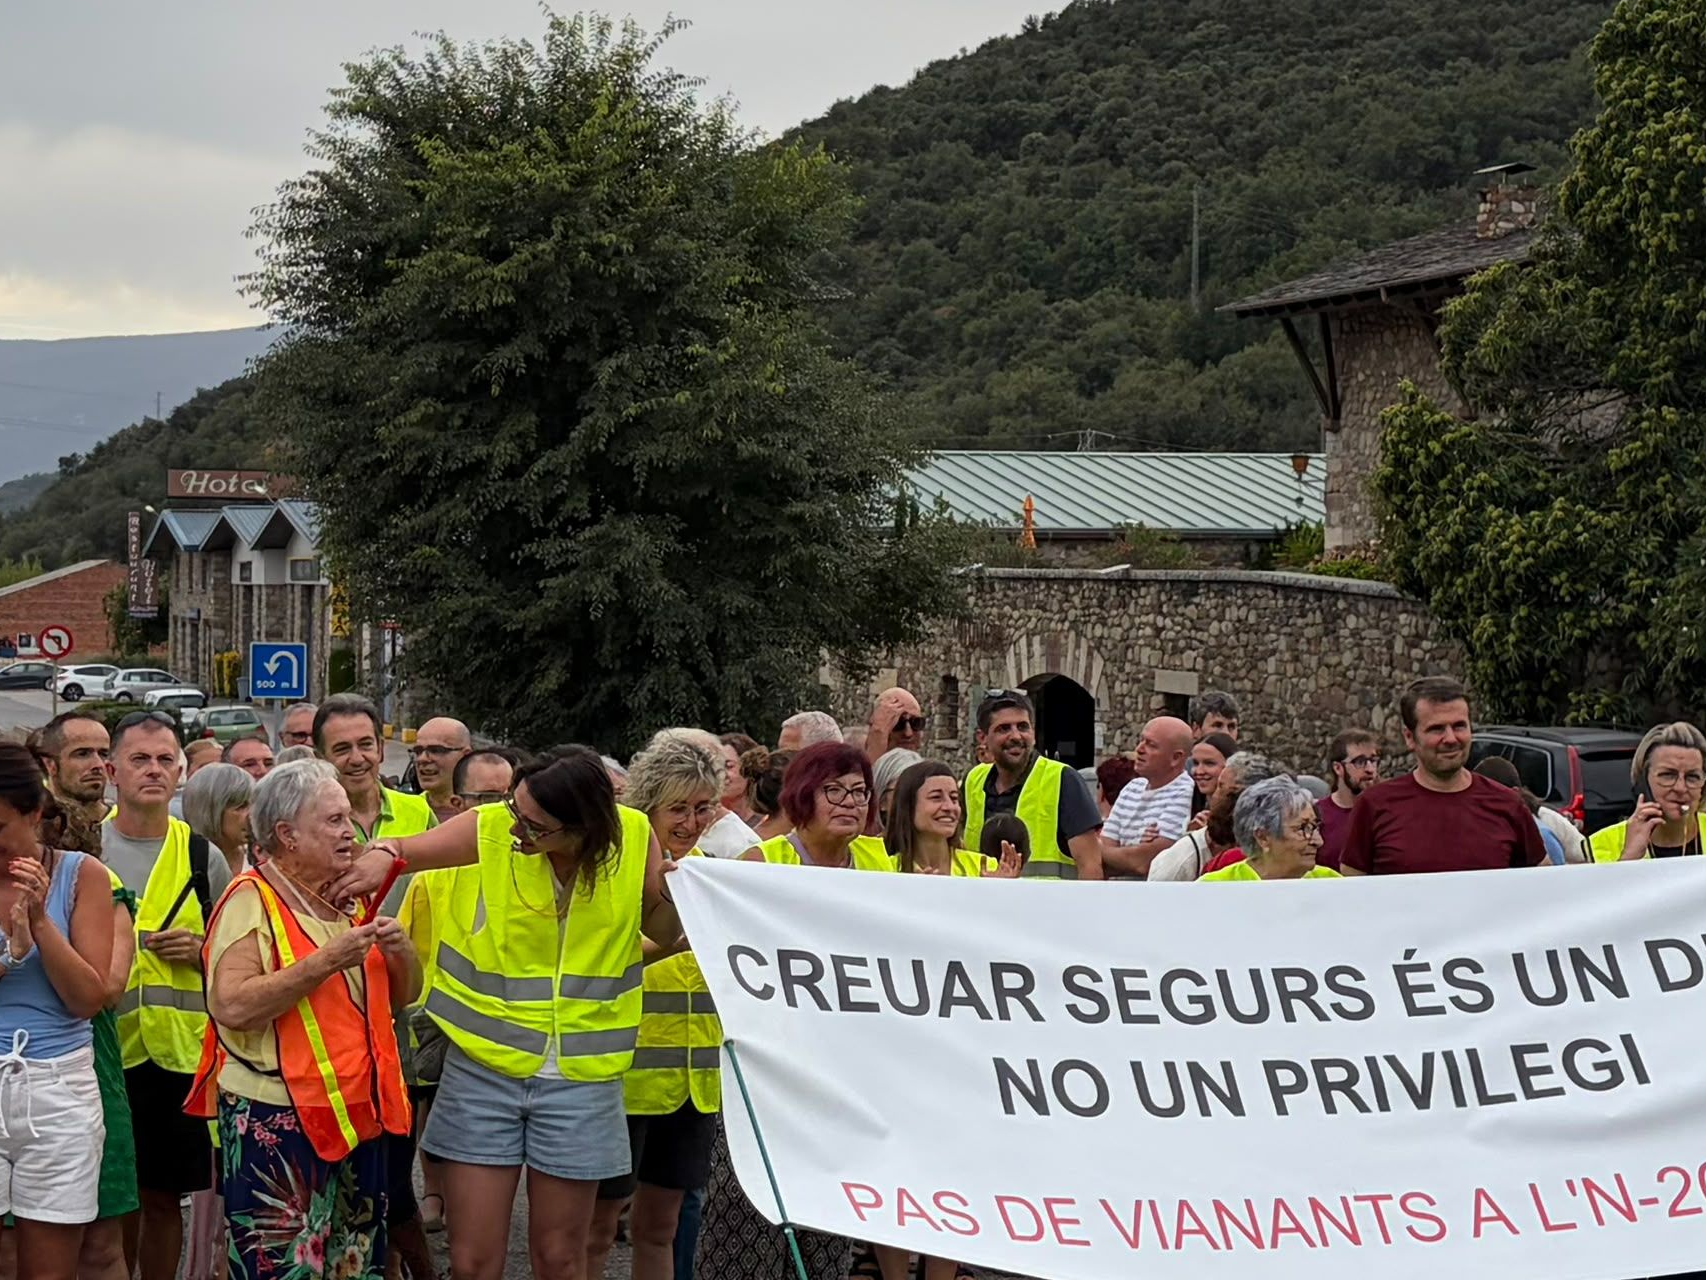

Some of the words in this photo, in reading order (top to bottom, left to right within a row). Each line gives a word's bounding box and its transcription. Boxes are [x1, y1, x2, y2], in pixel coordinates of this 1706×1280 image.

[726, 943, 1047, 1023] CREUAR
[1061, 964, 1377, 1026] SEGURS
[1391, 946, 1496, 1018] ÉS
[1510, 943, 1631, 1008] UN
[992, 1057, 1111, 1118] NO
[1128, 1060, 1247, 1119] UN
[1261, 1032, 1652, 1117] PRIVILEGI
[841, 1180, 981, 1238] PAS
[995, 1195, 1092, 1248] DE
[1099, 1191, 1447, 1251] VIANANTS
[1473, 1187, 1521, 1240] A
